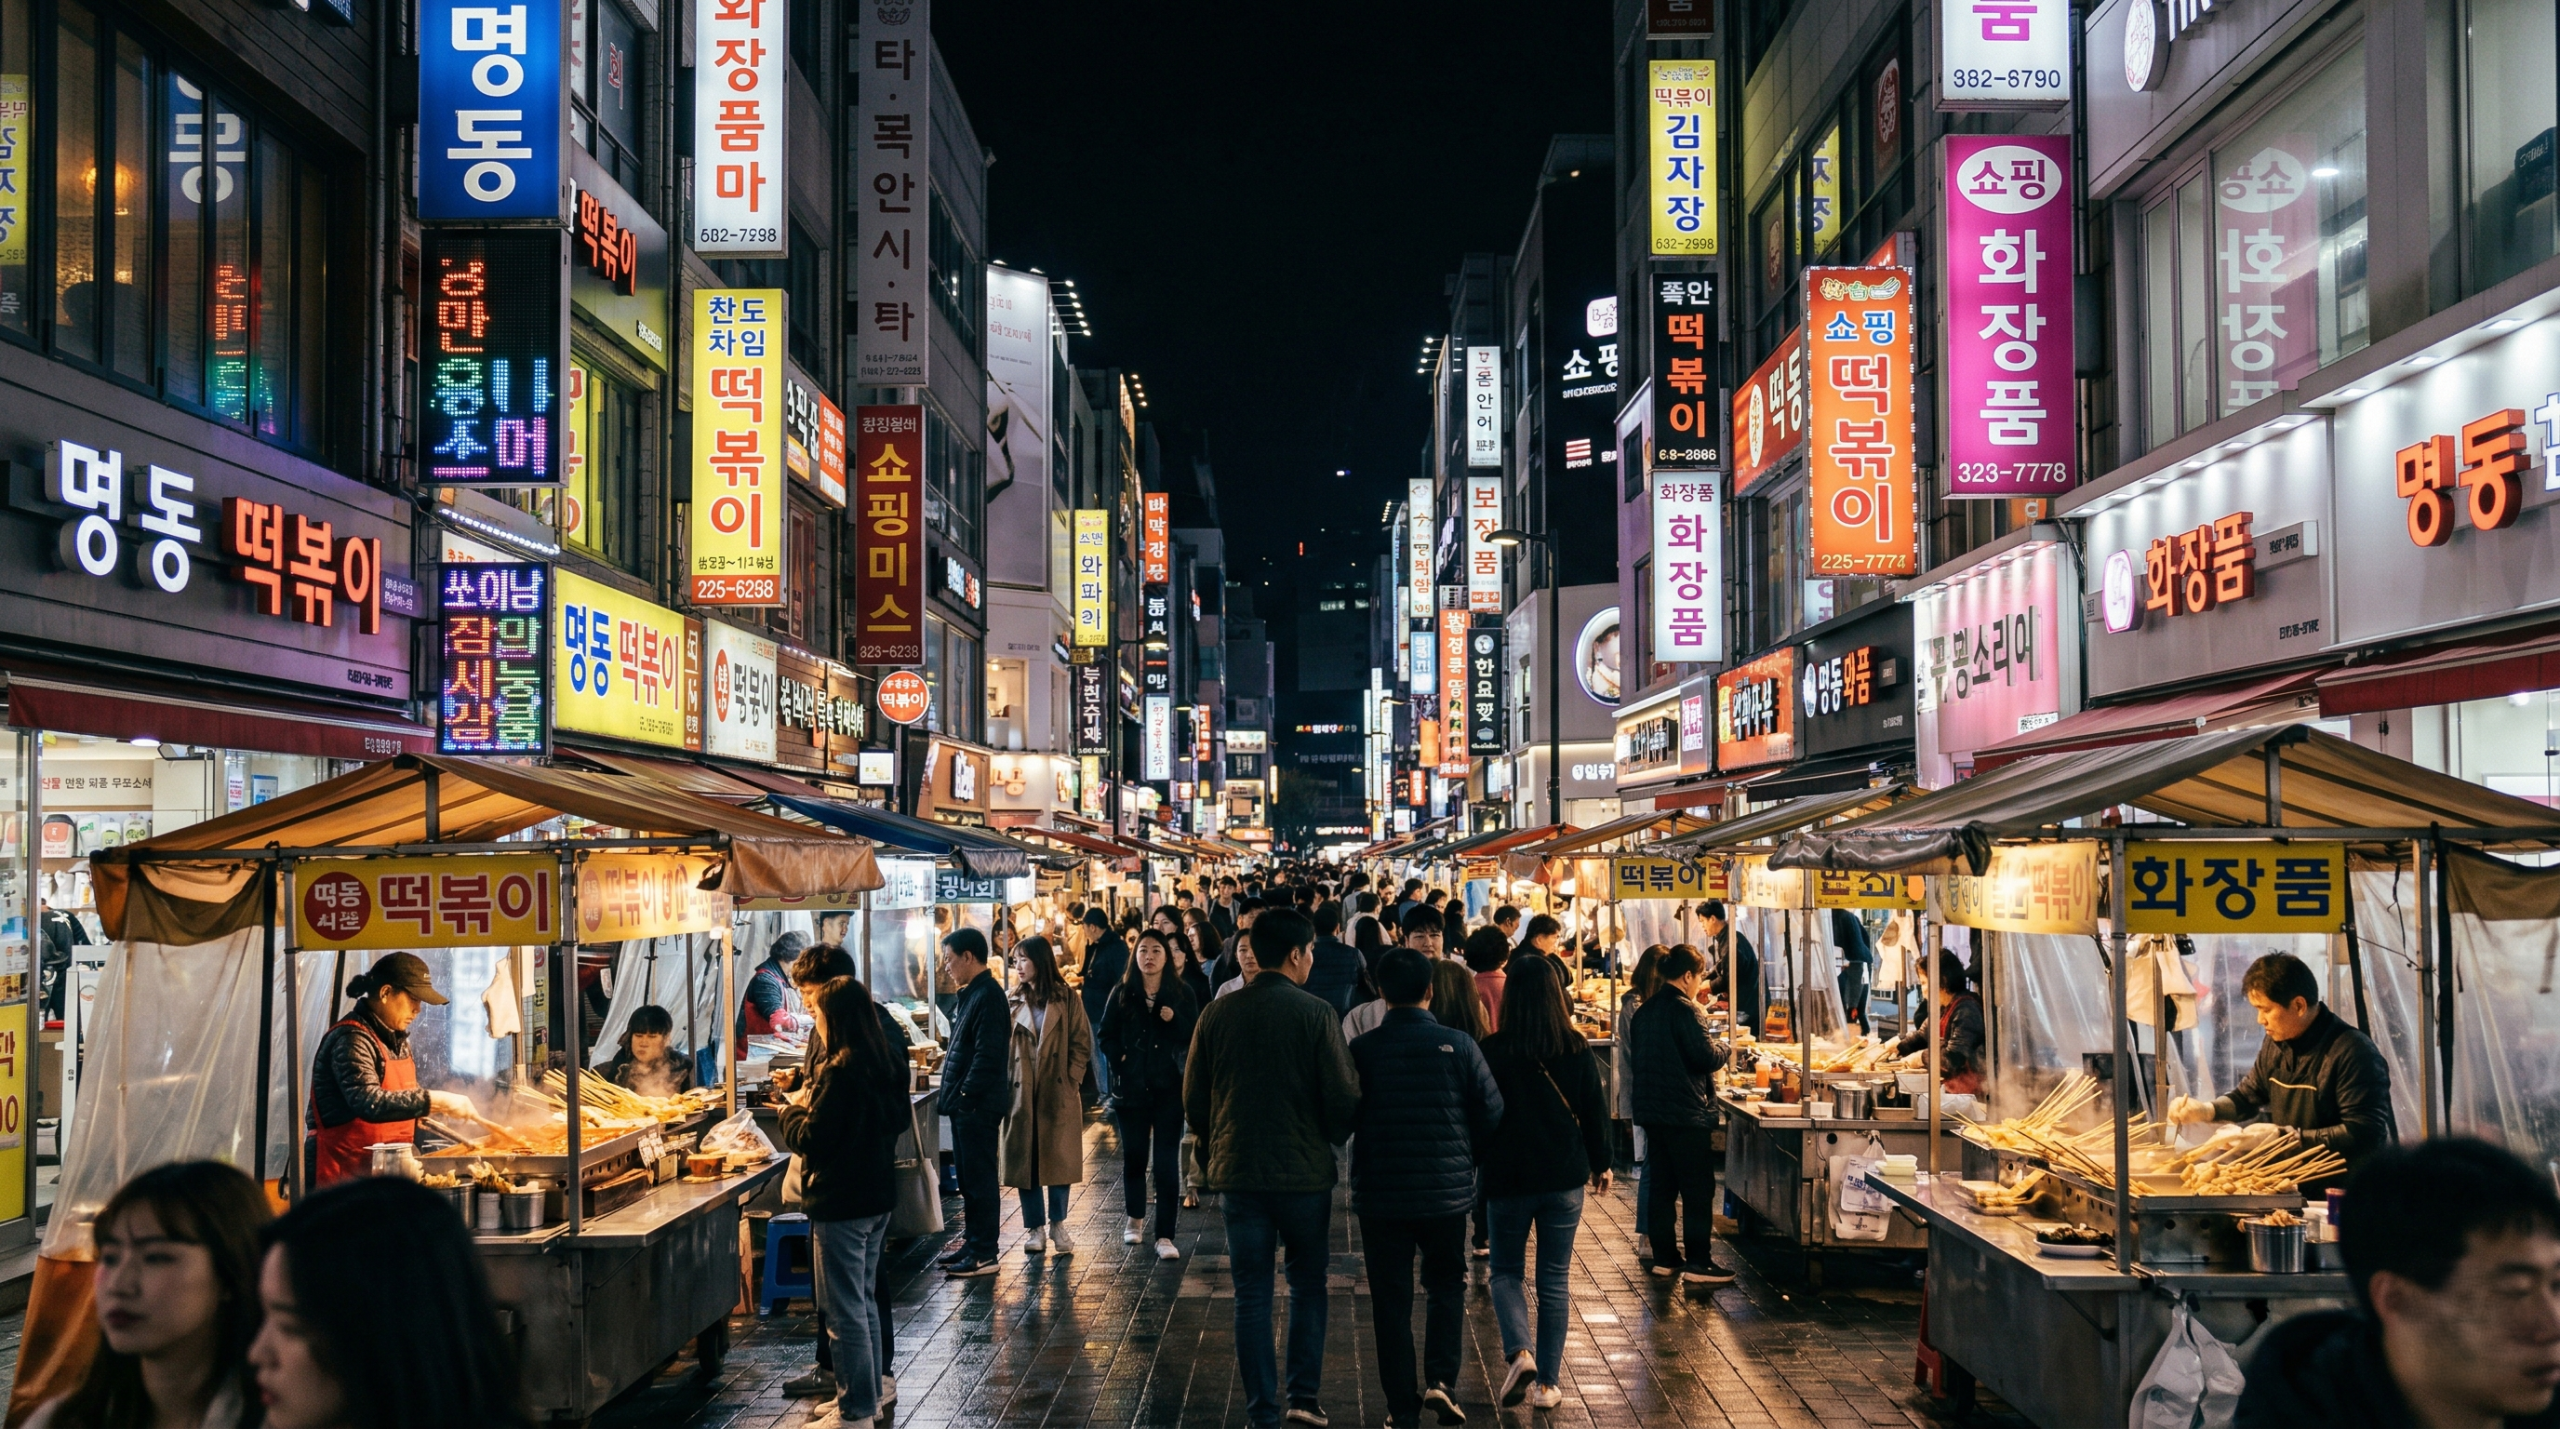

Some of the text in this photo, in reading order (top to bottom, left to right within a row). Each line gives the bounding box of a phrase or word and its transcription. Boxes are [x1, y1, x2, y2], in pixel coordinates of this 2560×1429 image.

[447, 5, 532, 202] 명동
[1666, 115, 1705, 232] 김자장
[1969, 159, 2045, 200] 쇼핑
[581, 190, 637, 296] 떡볶이
[1667, 313, 1707, 438] 떡볶이
[1825, 311, 1896, 343] 쇼핑
[1978, 229, 2047, 445] 화장품
[709, 368, 766, 548] 떡볶이
[1660, 484, 1715, 502] 화장품
[1829, 355, 1894, 542] 떡볶이
[1958, 462, 2067, 482] 323-7778
[2395, 409, 2517, 547] 명동
[60, 439, 201, 594] 명동
[237, 497, 381, 635] 떡볶이
[866, 444, 912, 633] 쇼핑미스
[2146, 512, 2247, 617] 화장품
[1668, 515, 1708, 646] 화장품
[564, 604, 612, 697] 명동
[619, 620, 679, 711] 떡볶이
[1819, 657, 1843, 715] 명동
[380, 870, 550, 935] 떡볶이
[2131, 856, 2331, 920] 화장품
